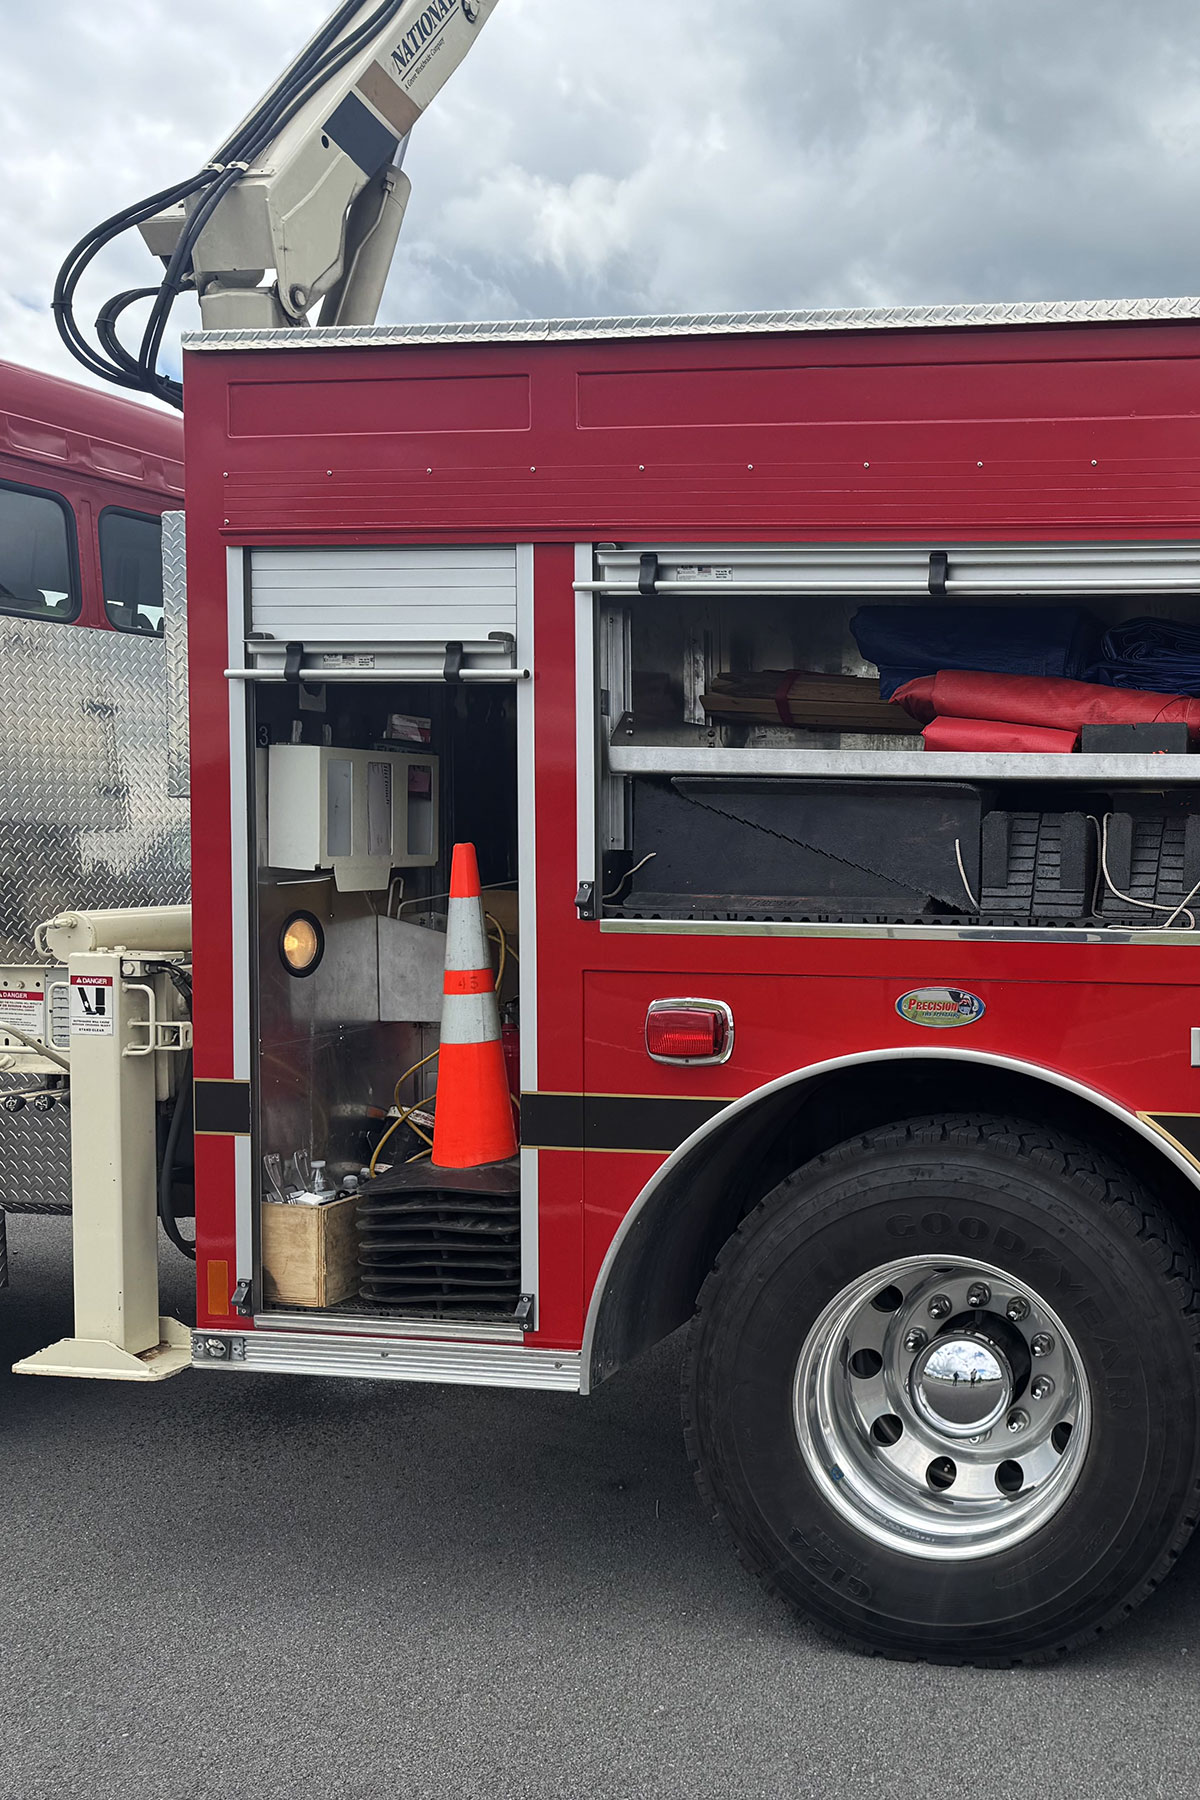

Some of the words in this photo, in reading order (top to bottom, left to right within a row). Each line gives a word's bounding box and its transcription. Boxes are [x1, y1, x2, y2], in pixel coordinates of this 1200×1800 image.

[259, 726, 269, 746] 3
[82, 977, 108, 985] DANGER
[908, 998, 959, 1012] PRECISION
